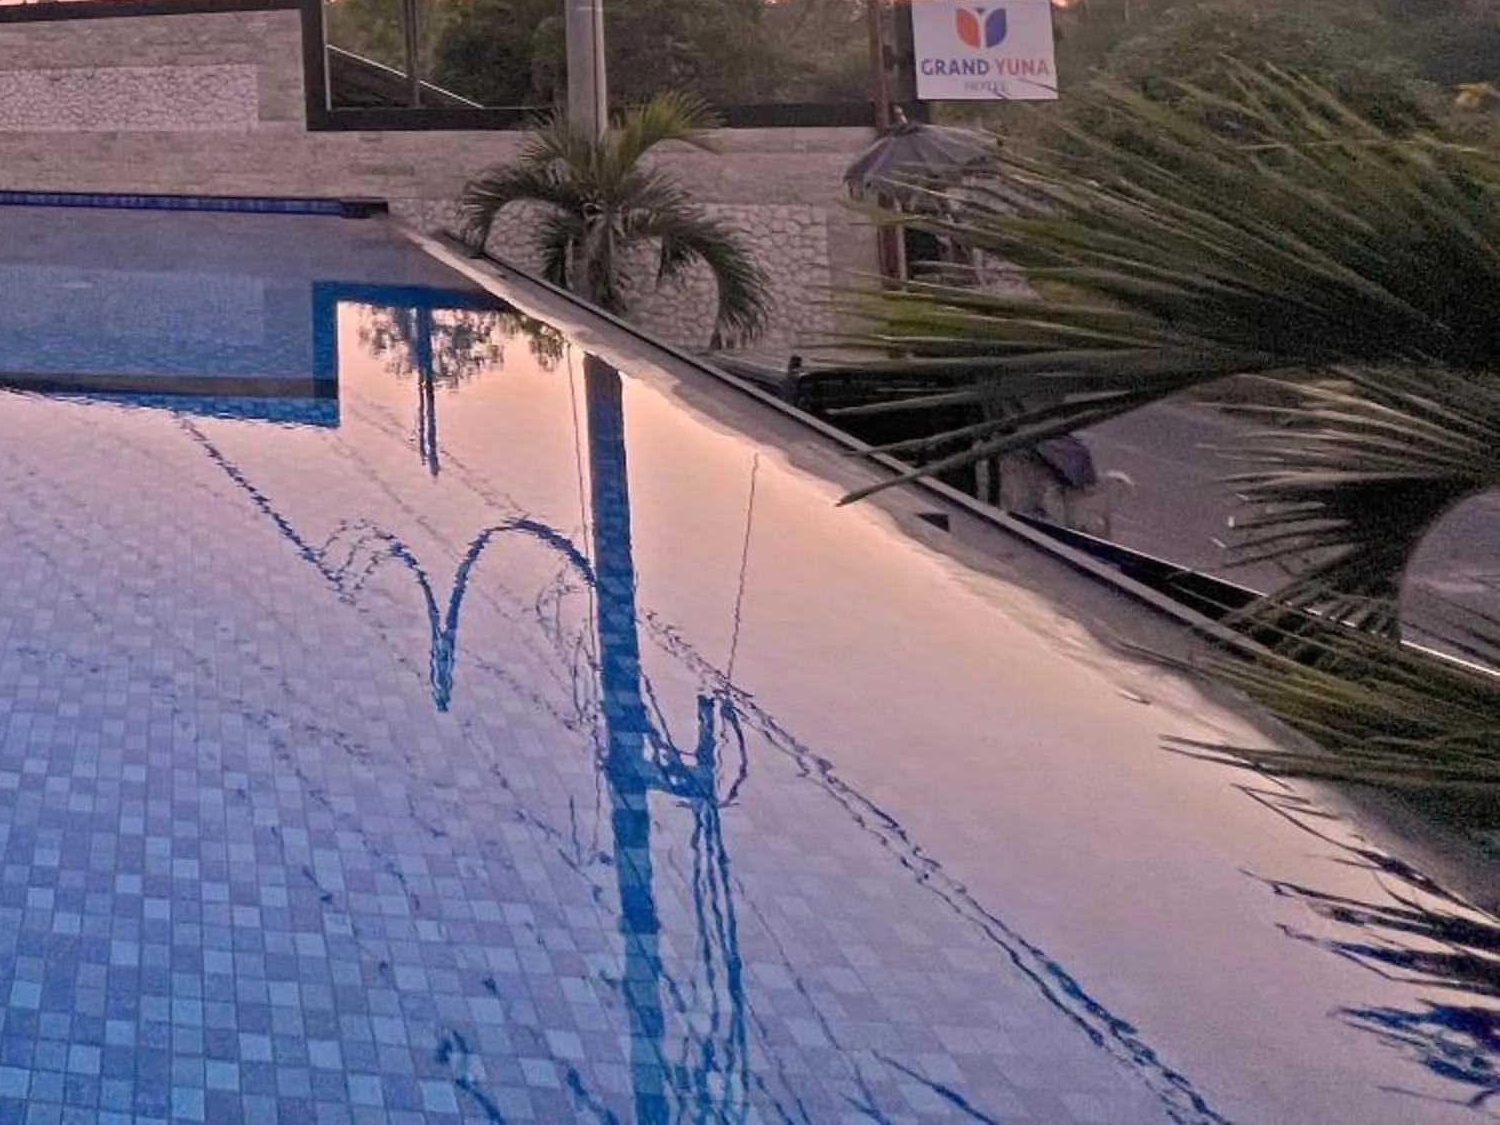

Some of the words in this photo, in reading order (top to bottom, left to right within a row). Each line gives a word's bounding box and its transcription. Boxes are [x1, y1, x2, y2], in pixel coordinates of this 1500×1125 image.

[921, 58, 990, 76] GRAND
[994, 58, 1049, 76] YUNA
[964, 81, 1007, 93] HOTEL
